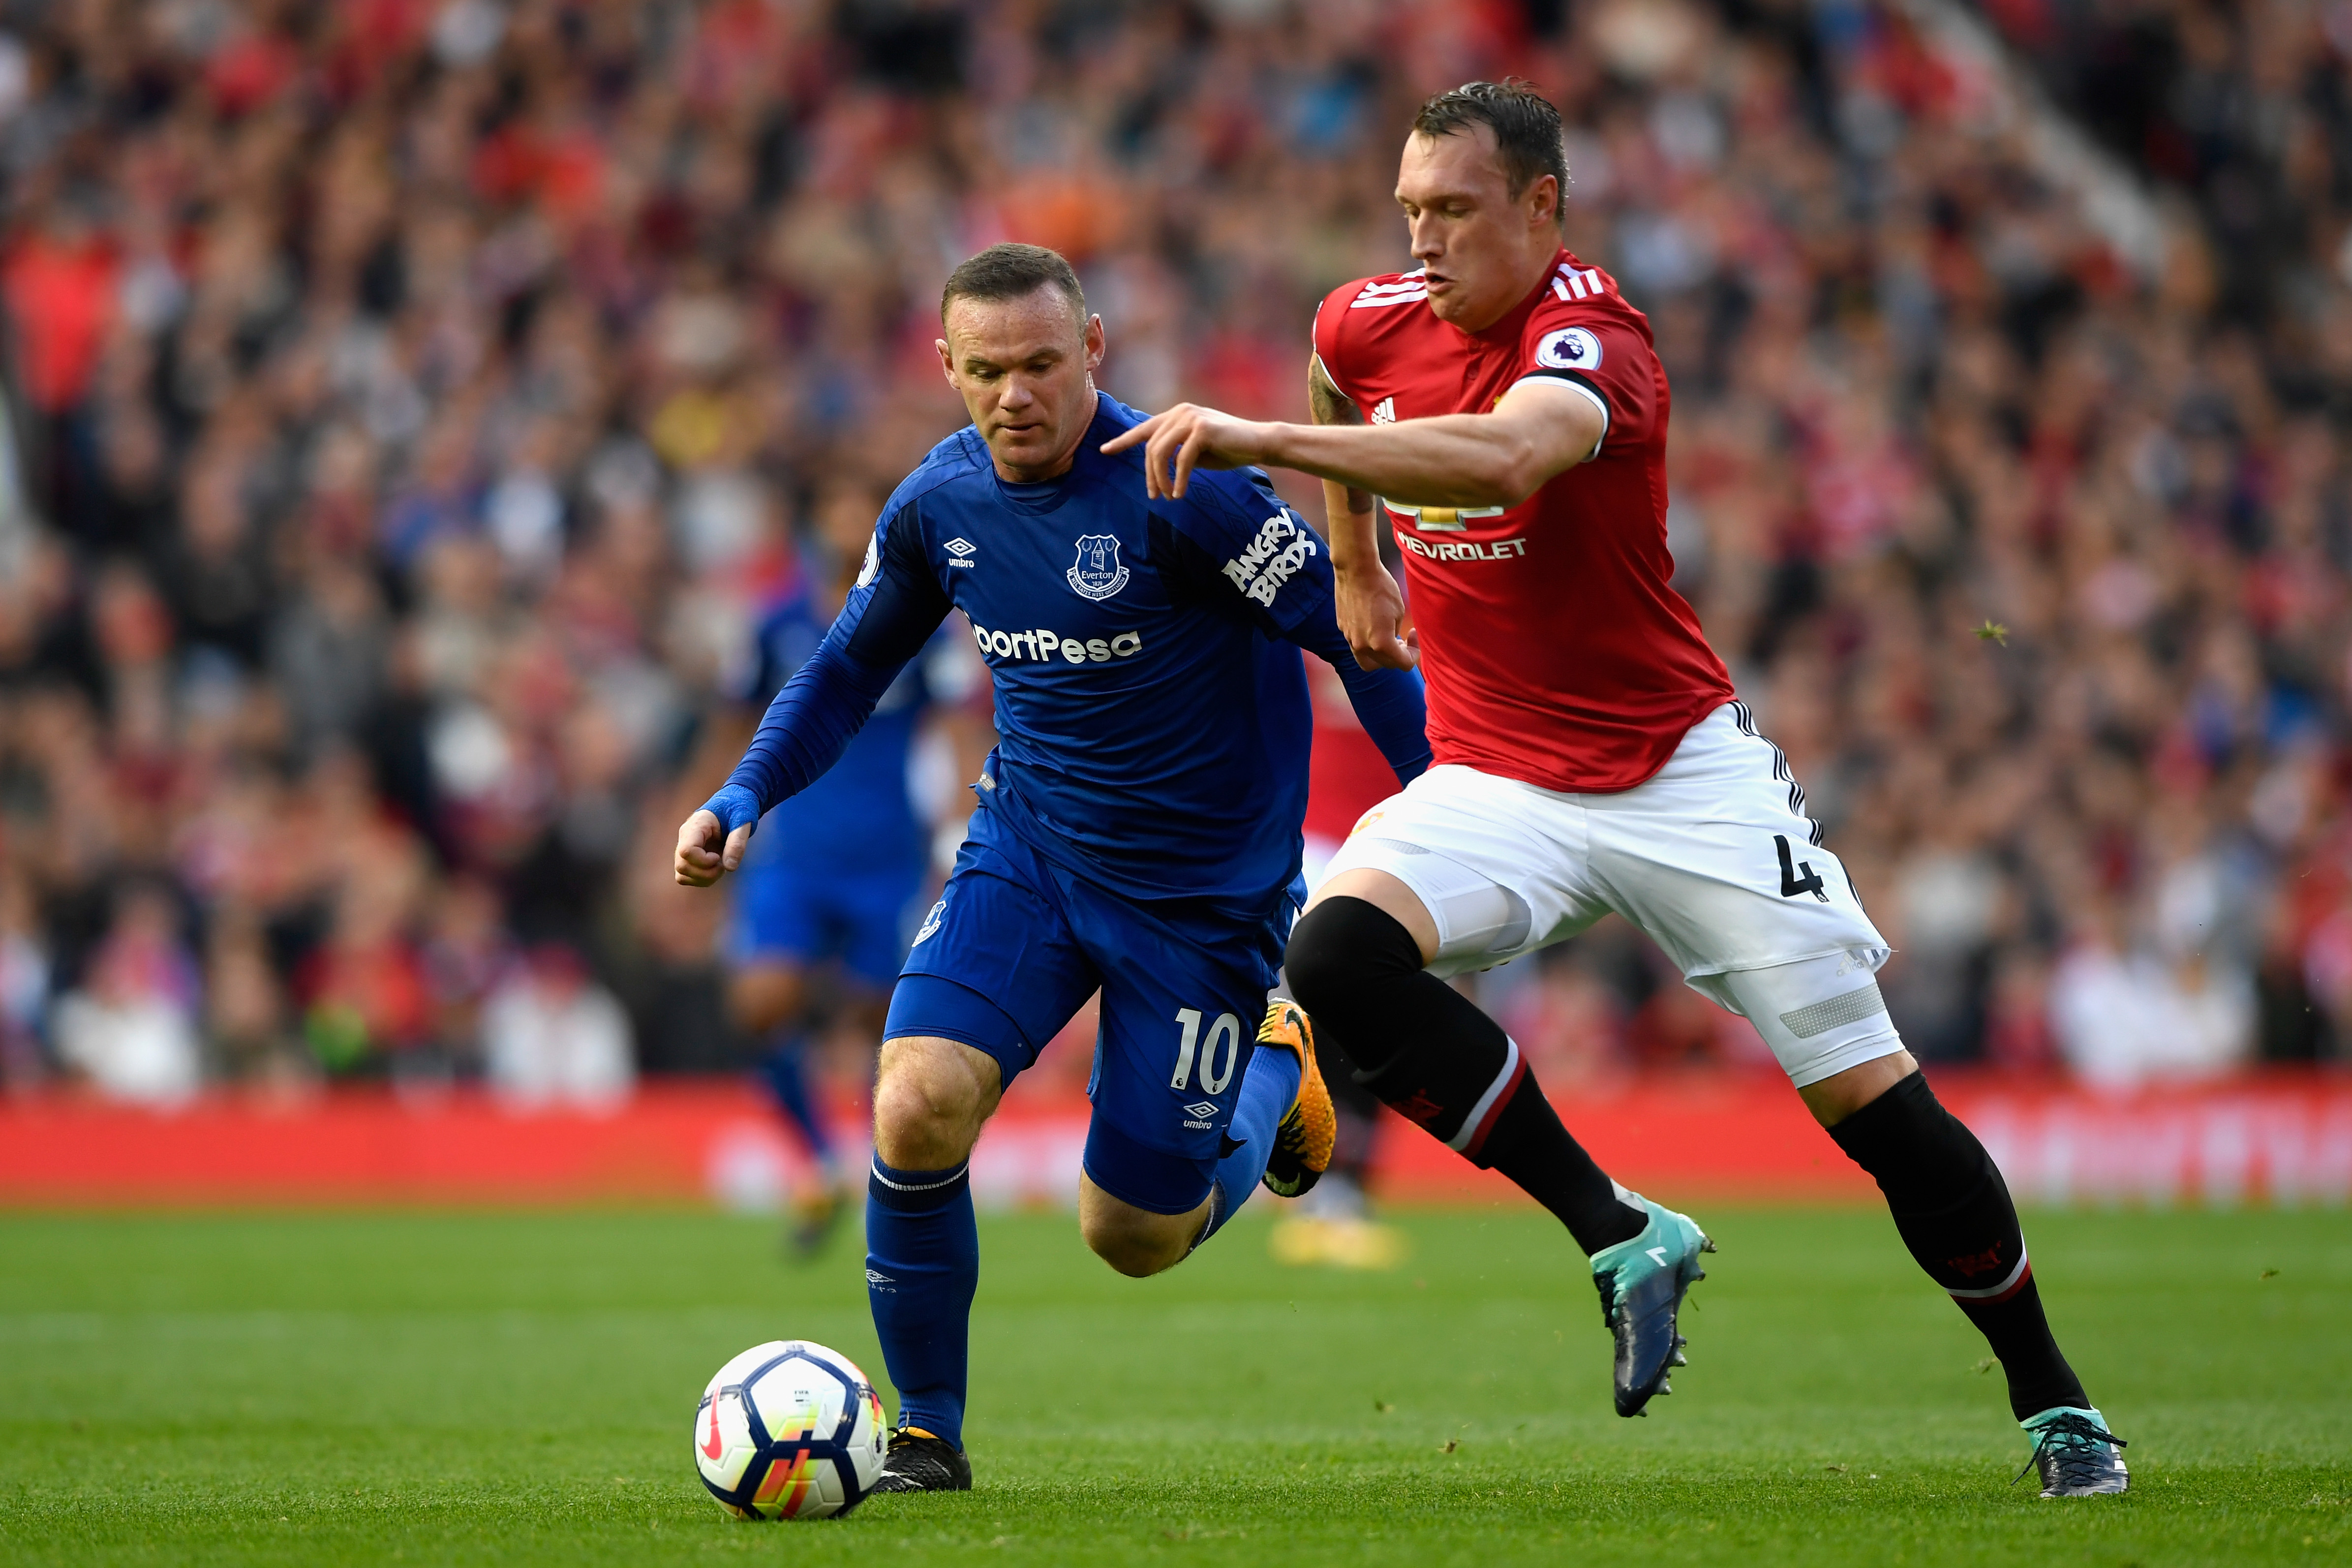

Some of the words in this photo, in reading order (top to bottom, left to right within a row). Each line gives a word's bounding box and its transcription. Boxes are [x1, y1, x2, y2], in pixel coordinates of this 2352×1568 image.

[948, 557, 974, 568] umbro
[1221, 507, 1296, 592] ANGRY
[1397, 531, 1526, 561] HEVROLET
[1077, 586, 1091, 596] SATIS
[1105, 577, 1126, 595] OPTIMUM
[1082, 571, 1114, 579] Everton
[1246, 528, 1316, 607] BIRDS
[964, 610, 1142, 664] portPesa
[1773, 834, 1830, 903] 4
[1170, 1008, 1240, 1095] 10
[1183, 1120, 1212, 1129] umbro
